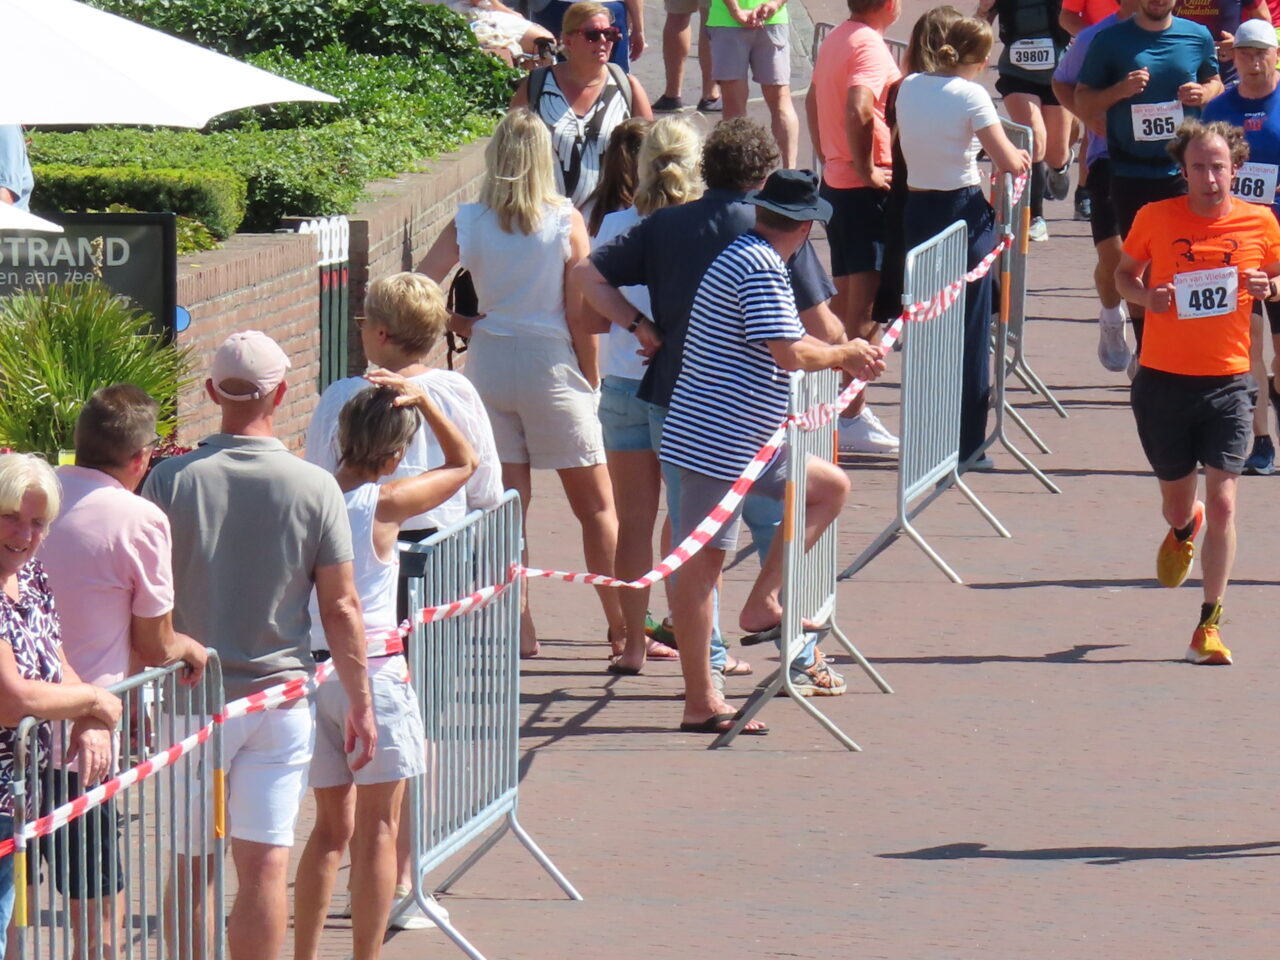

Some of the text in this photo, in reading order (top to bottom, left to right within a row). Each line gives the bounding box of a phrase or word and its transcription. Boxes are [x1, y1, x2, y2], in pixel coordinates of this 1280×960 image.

[1015, 50, 1050, 63] 39807
[1142, 116, 1175, 137] 365
[1231, 176, 1265, 198] 468
[25, 271, 57, 285] aan
[64, 271, 95, 285] zee
[1188, 286, 1229, 311] 482
